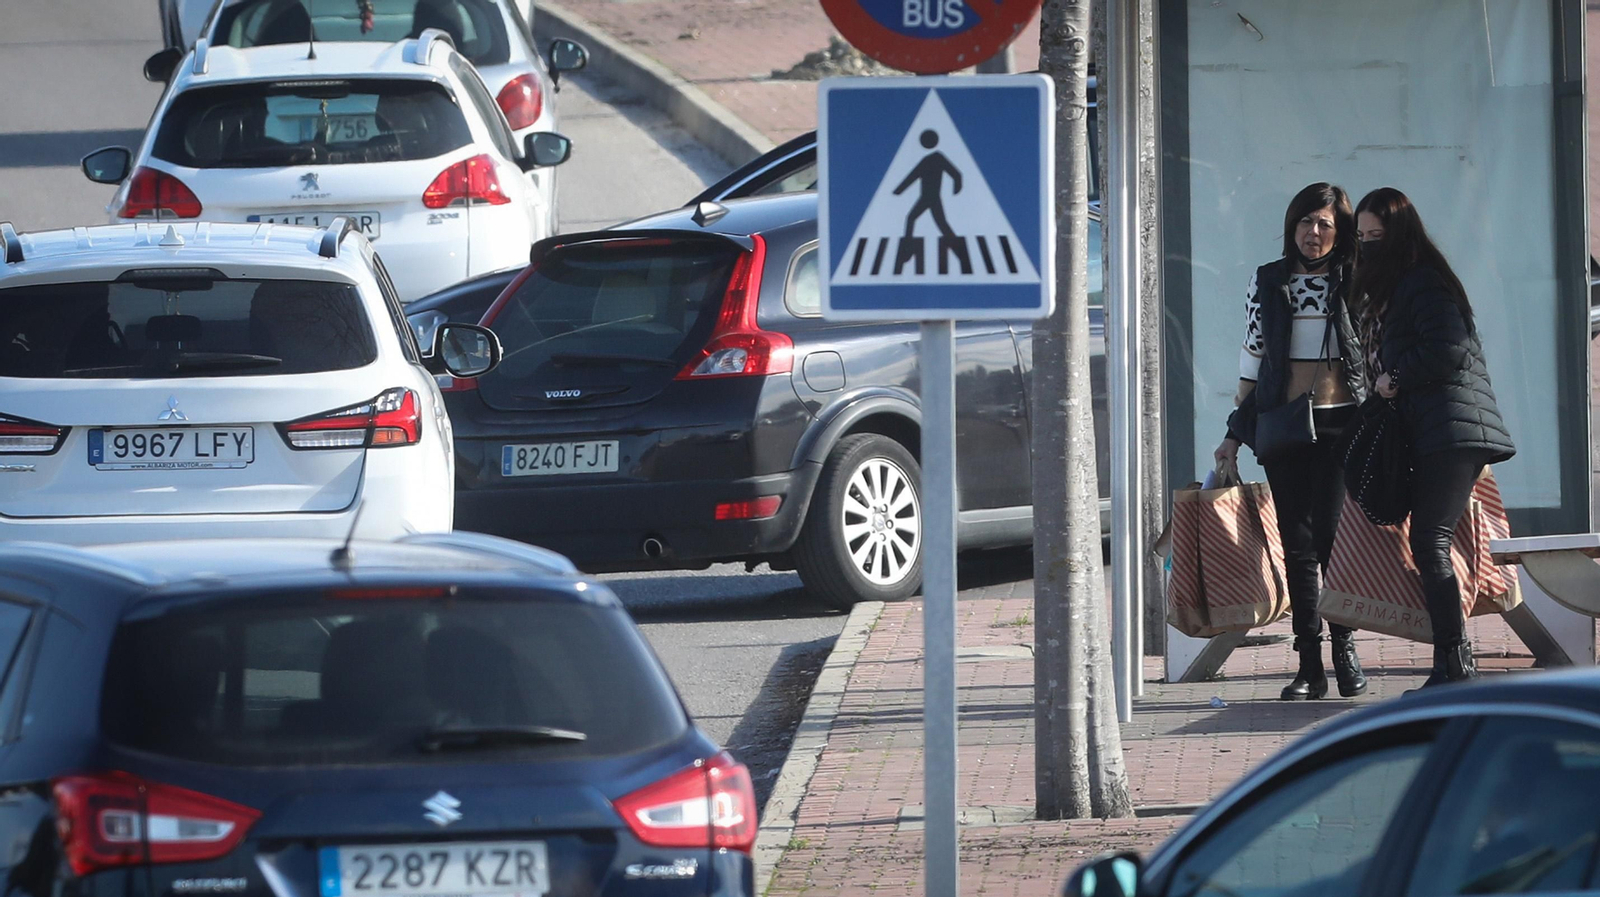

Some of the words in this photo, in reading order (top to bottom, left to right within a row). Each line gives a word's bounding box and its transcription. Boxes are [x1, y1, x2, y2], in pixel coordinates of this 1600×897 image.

[902, 0, 964, 29] BUS
[544, 389, 581, 399] VOLVO
[93, 449, 100, 457] E
[113, 432, 184, 459] 9967
[194, 431, 248, 458] LFY
[515, 445, 566, 470] 8240
[573, 443, 612, 468] FJT
[1341, 598, 1425, 628] PRIMARK
[353, 851, 450, 891] 2287
[464, 850, 537, 887] KZR
